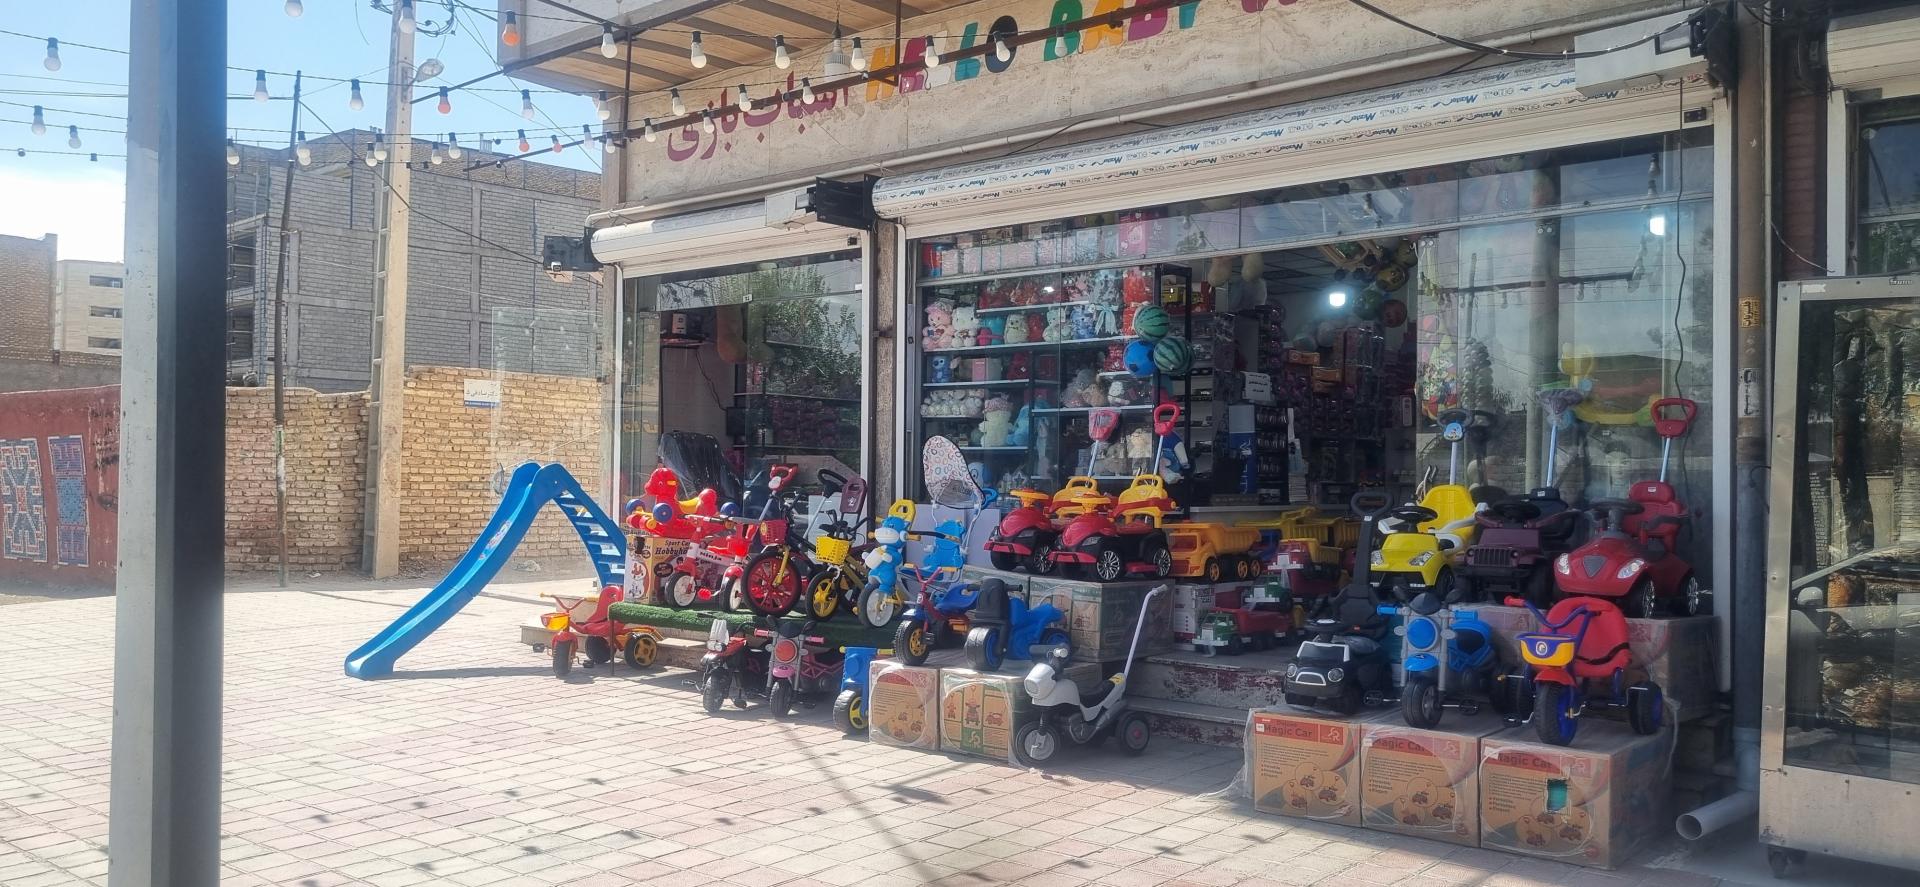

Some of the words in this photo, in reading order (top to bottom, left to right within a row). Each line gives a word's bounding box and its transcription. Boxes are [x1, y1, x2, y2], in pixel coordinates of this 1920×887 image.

[865, 15, 1018, 102] HELLO
[667, 87, 739, 162] بازی
[743, 70, 850, 144] اسباب
[655, 547, 690, 557] Hobbyho
[1264, 724, 1293, 737] Magic
[1295, 728, 1313, 737] Car
